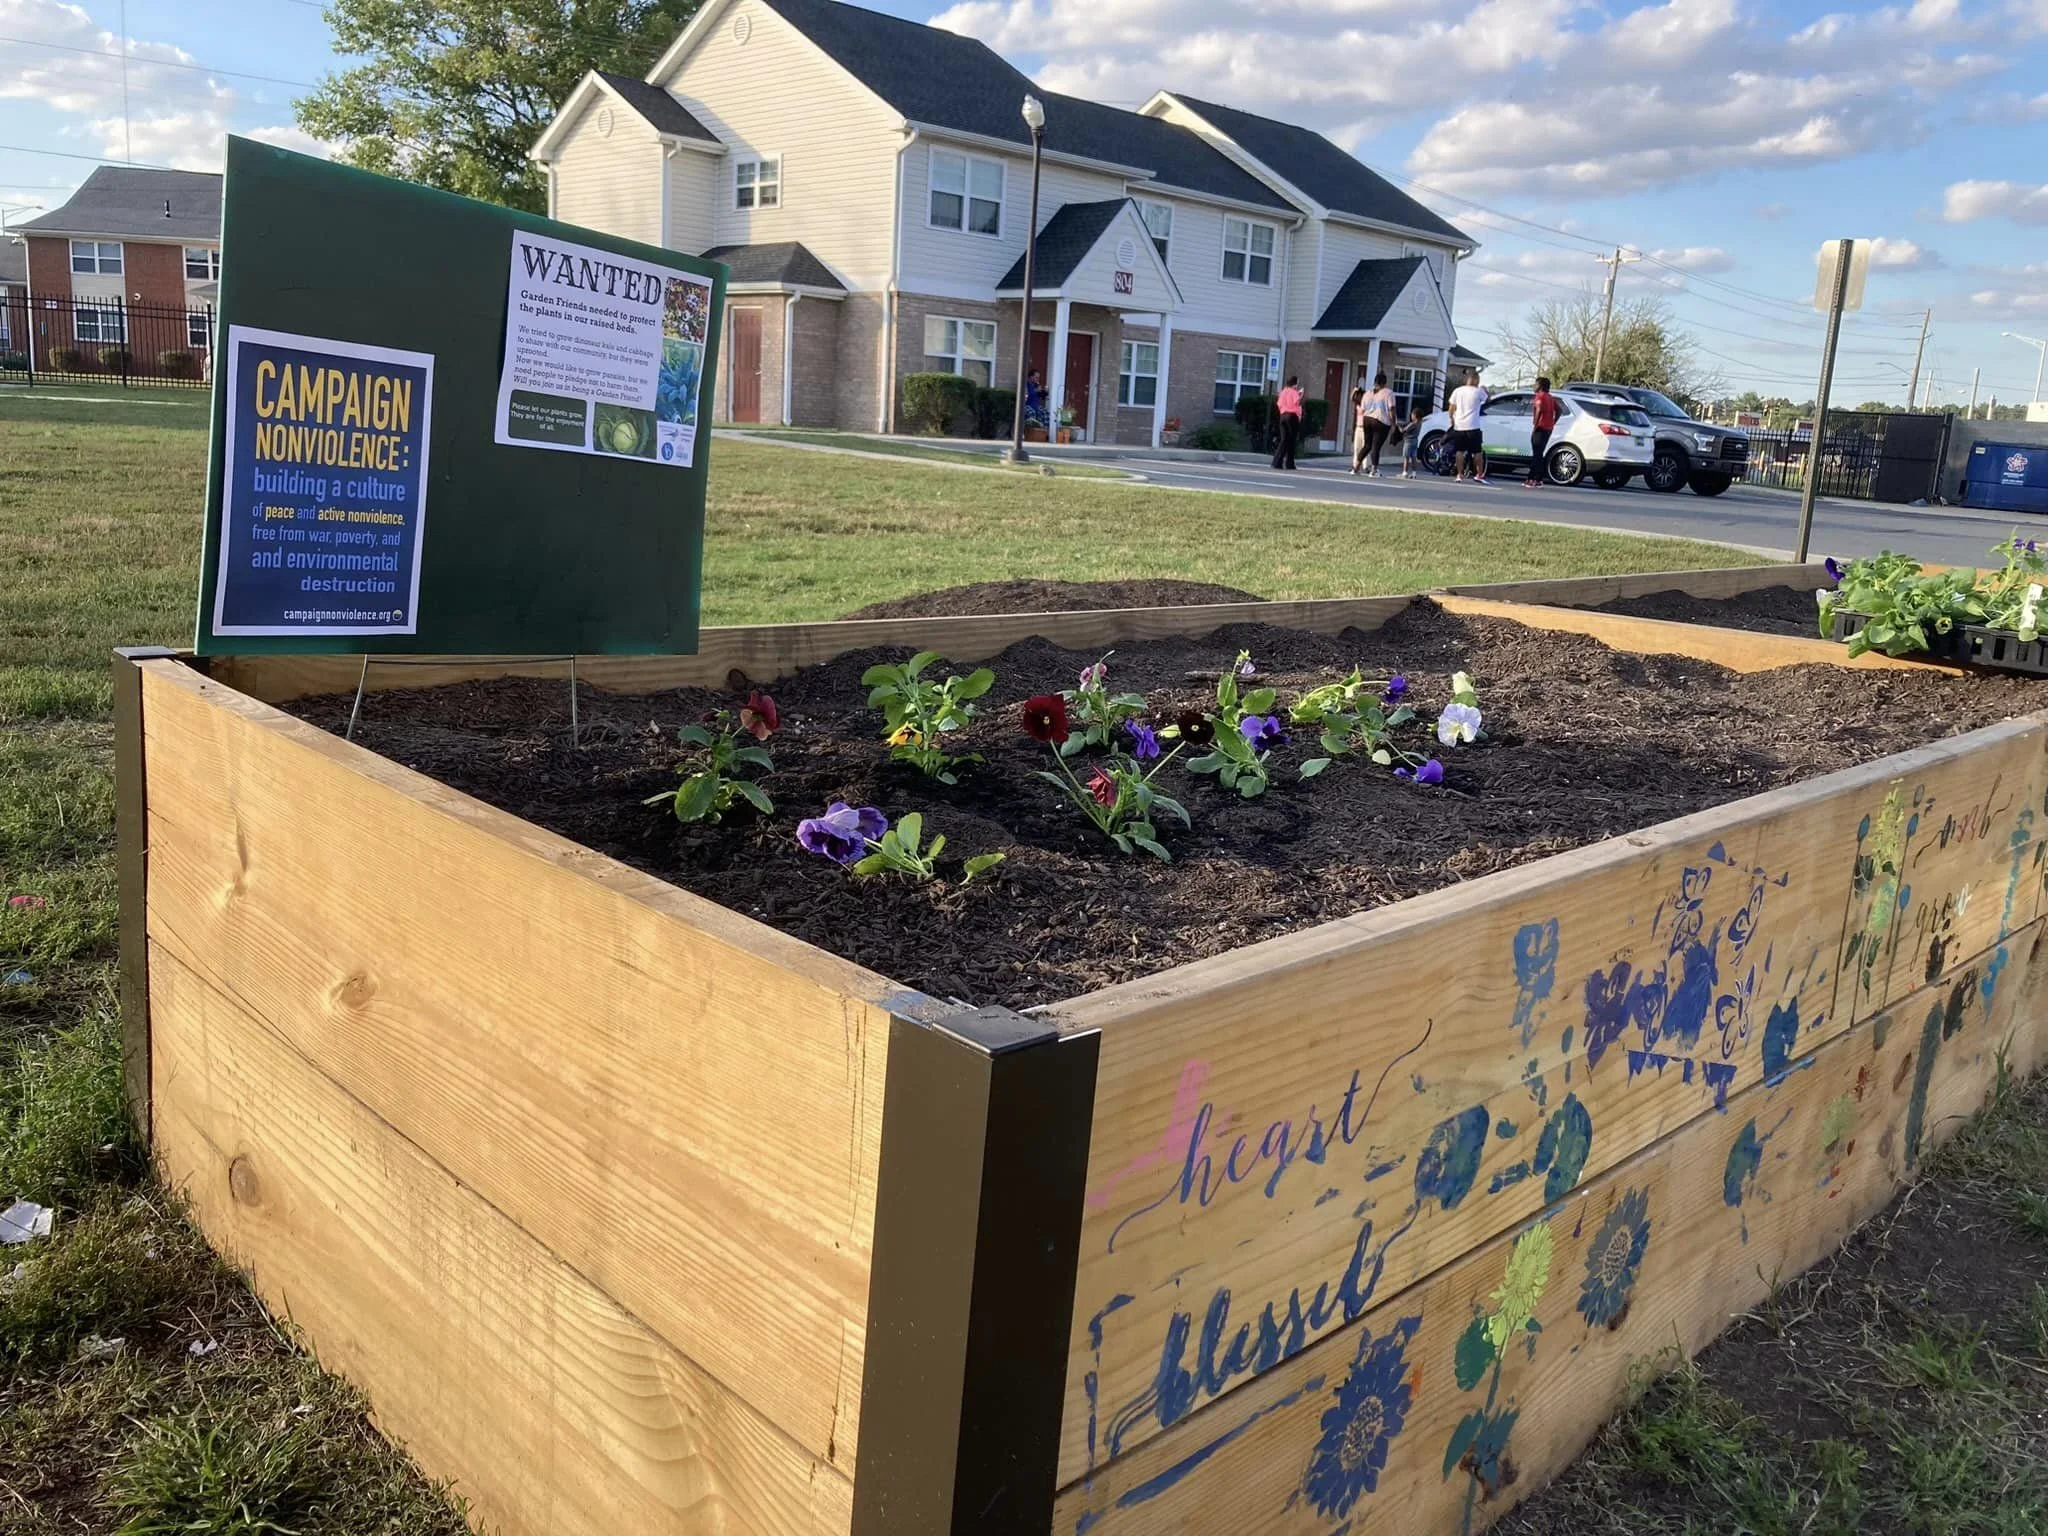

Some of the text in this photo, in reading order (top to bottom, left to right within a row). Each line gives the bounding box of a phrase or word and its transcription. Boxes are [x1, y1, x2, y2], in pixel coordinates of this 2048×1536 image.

[520, 244, 662, 305] WANTED
[1115, 272, 1132, 292] 804
[519, 303, 637, 335] the plants in our raised beds.
[520, 290, 656, 327] Garden Friends needed to protect
[517, 335, 525, 343] to
[519, 324, 530, 334] We
[531, 327, 547, 337] tried
[616, 344, 628, 353] and
[516, 355, 531, 363] Now
[544, 361, 564, 370] would
[514, 367, 532, 375] need
[533, 369, 556, 379] people
[565, 374, 587, 385] pledge
[514, 375, 527, 384] Will
[528, 378, 541, 388] you
[542, 380, 554, 389] join
[572, 385, 589, 395] being
[595, 387, 619, 399] Garden
[255, 359, 412, 433] CAMPAIGN
[511, 402, 531, 411] Please
[510, 410, 524, 419] They
[255, 422, 409, 472] NONVIOLENCE:
[254, 467, 405, 502] building a culture
[252, 502, 263, 517] of
[265, 506, 295, 521] peace
[297, 505, 315, 519] and
[318, 507, 345, 522] active
[252, 524, 276, 541] free
[279, 525, 305, 542] from
[382, 532, 401, 546] and
[252, 546, 398, 572] and environmental
[300, 576, 395, 592] destruction
[284, 608, 391, 622] campaignnonviolence.org
